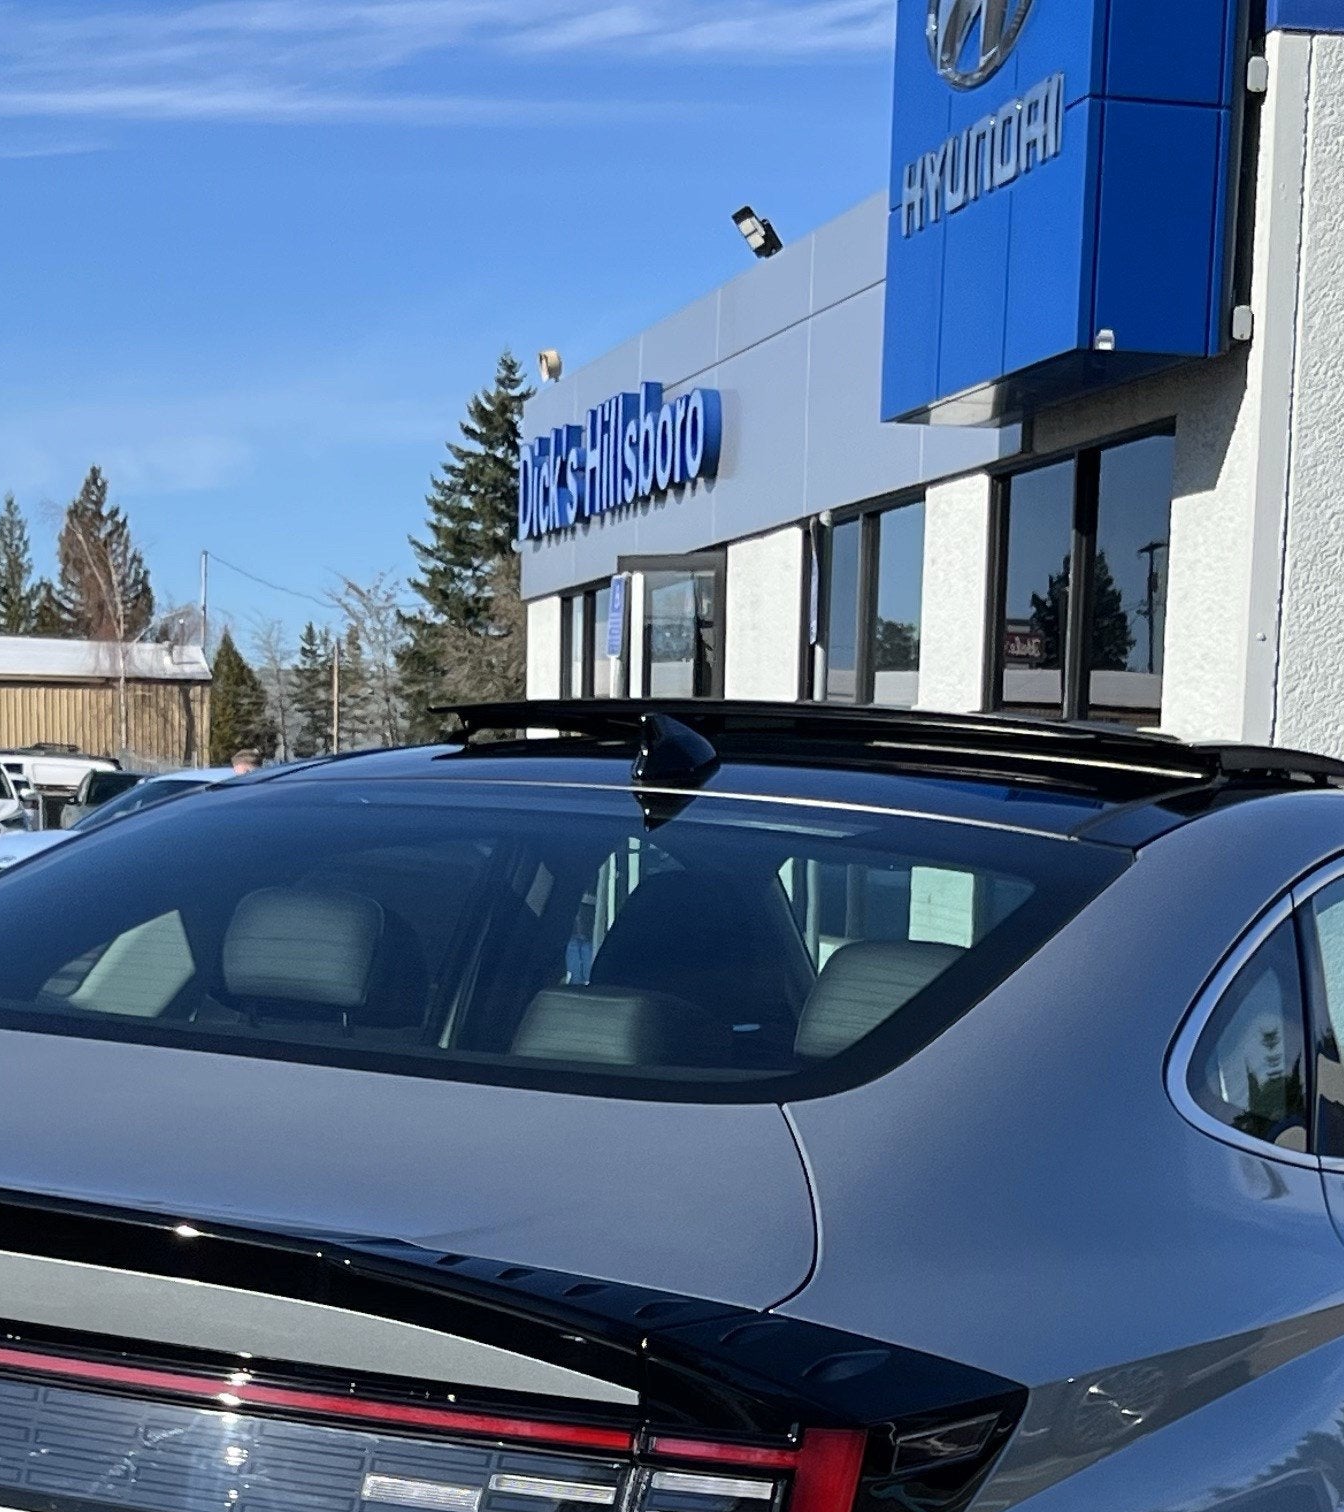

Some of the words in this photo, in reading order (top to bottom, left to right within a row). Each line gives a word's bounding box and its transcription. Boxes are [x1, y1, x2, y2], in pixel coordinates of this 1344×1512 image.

[901, 71, 1064, 238] HYUNDAI
[518, 424, 578, 541] Dick's
[584, 382, 706, 517] Hillsboro
